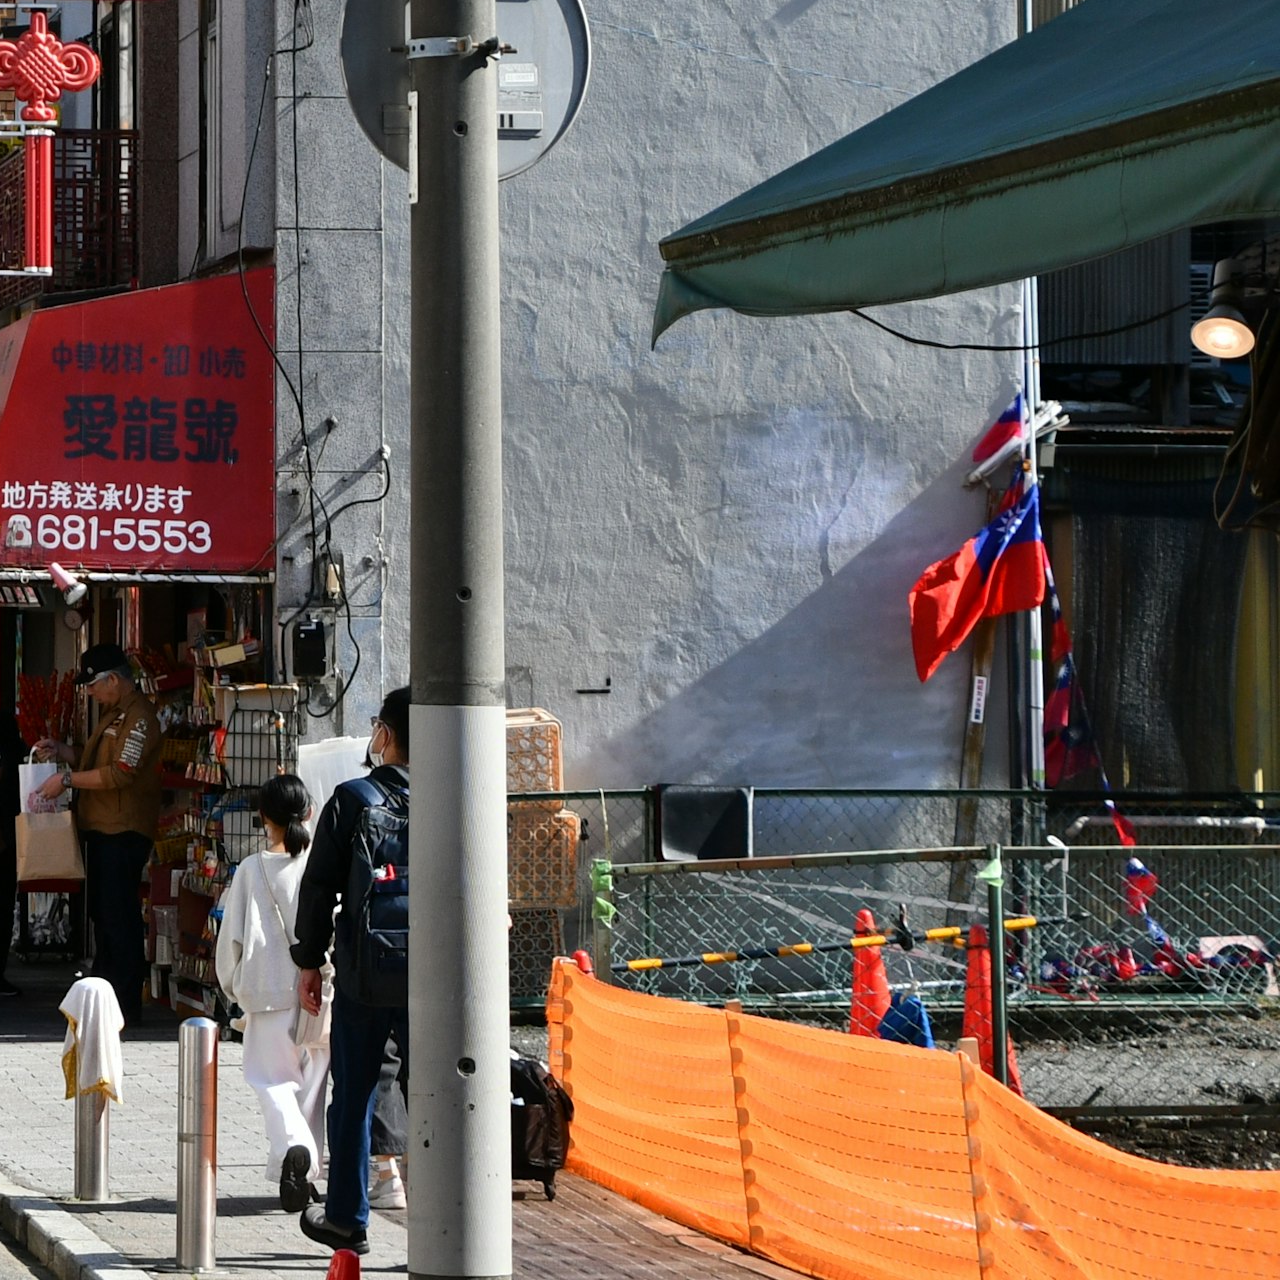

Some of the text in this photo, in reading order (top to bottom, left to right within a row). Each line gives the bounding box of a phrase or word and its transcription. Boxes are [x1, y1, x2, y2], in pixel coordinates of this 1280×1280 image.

[1, 480, 193, 515] 地方発送承ります
[37, 513, 213, 555] 681-5553
